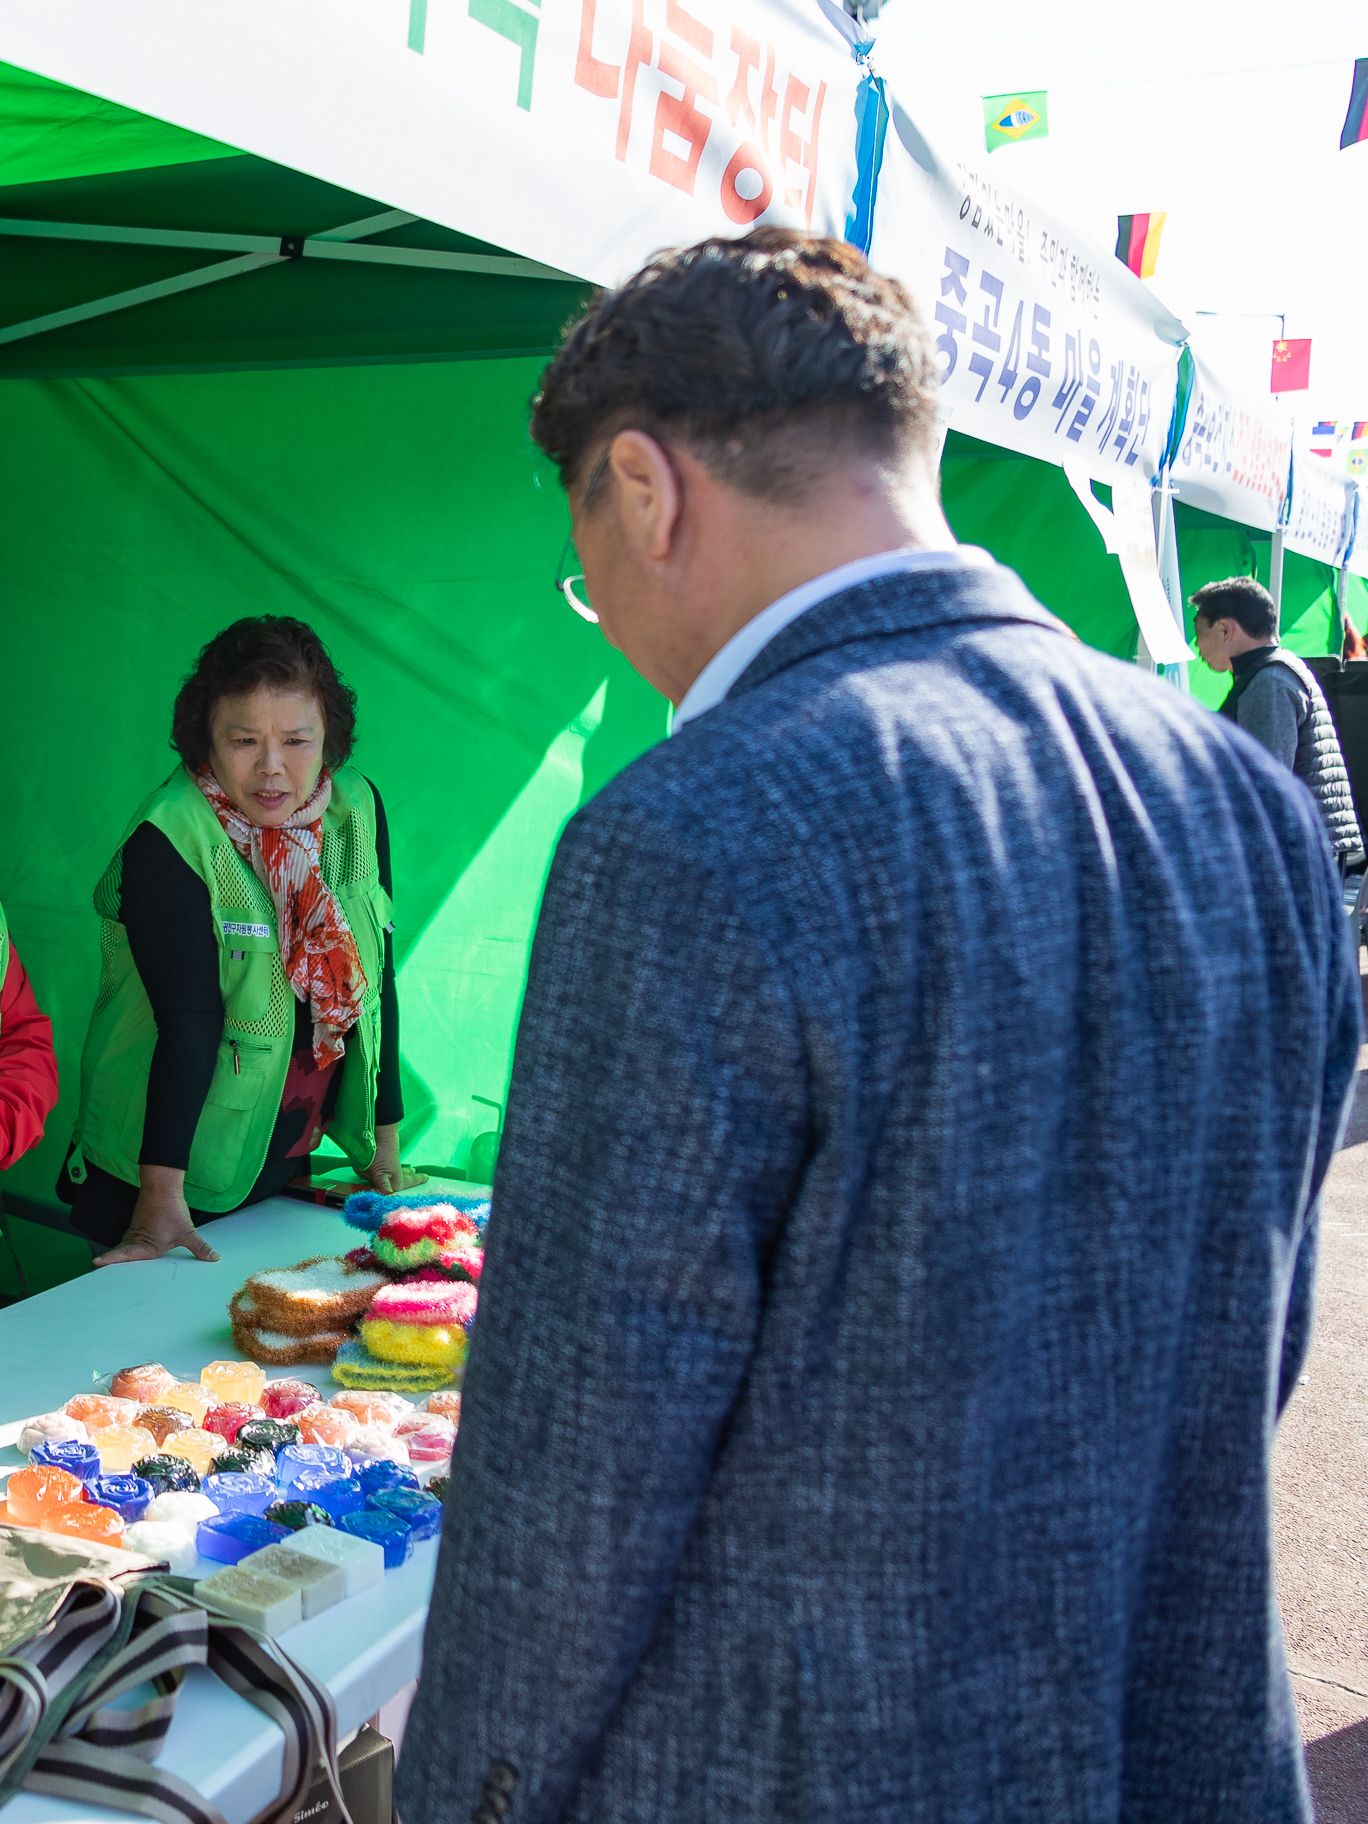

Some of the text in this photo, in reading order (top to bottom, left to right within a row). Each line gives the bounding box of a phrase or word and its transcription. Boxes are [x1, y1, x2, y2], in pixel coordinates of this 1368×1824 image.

[574, 0, 827, 232] 나눔장터
[934, 246, 1152, 466] 중곡4동 마을 계획단
